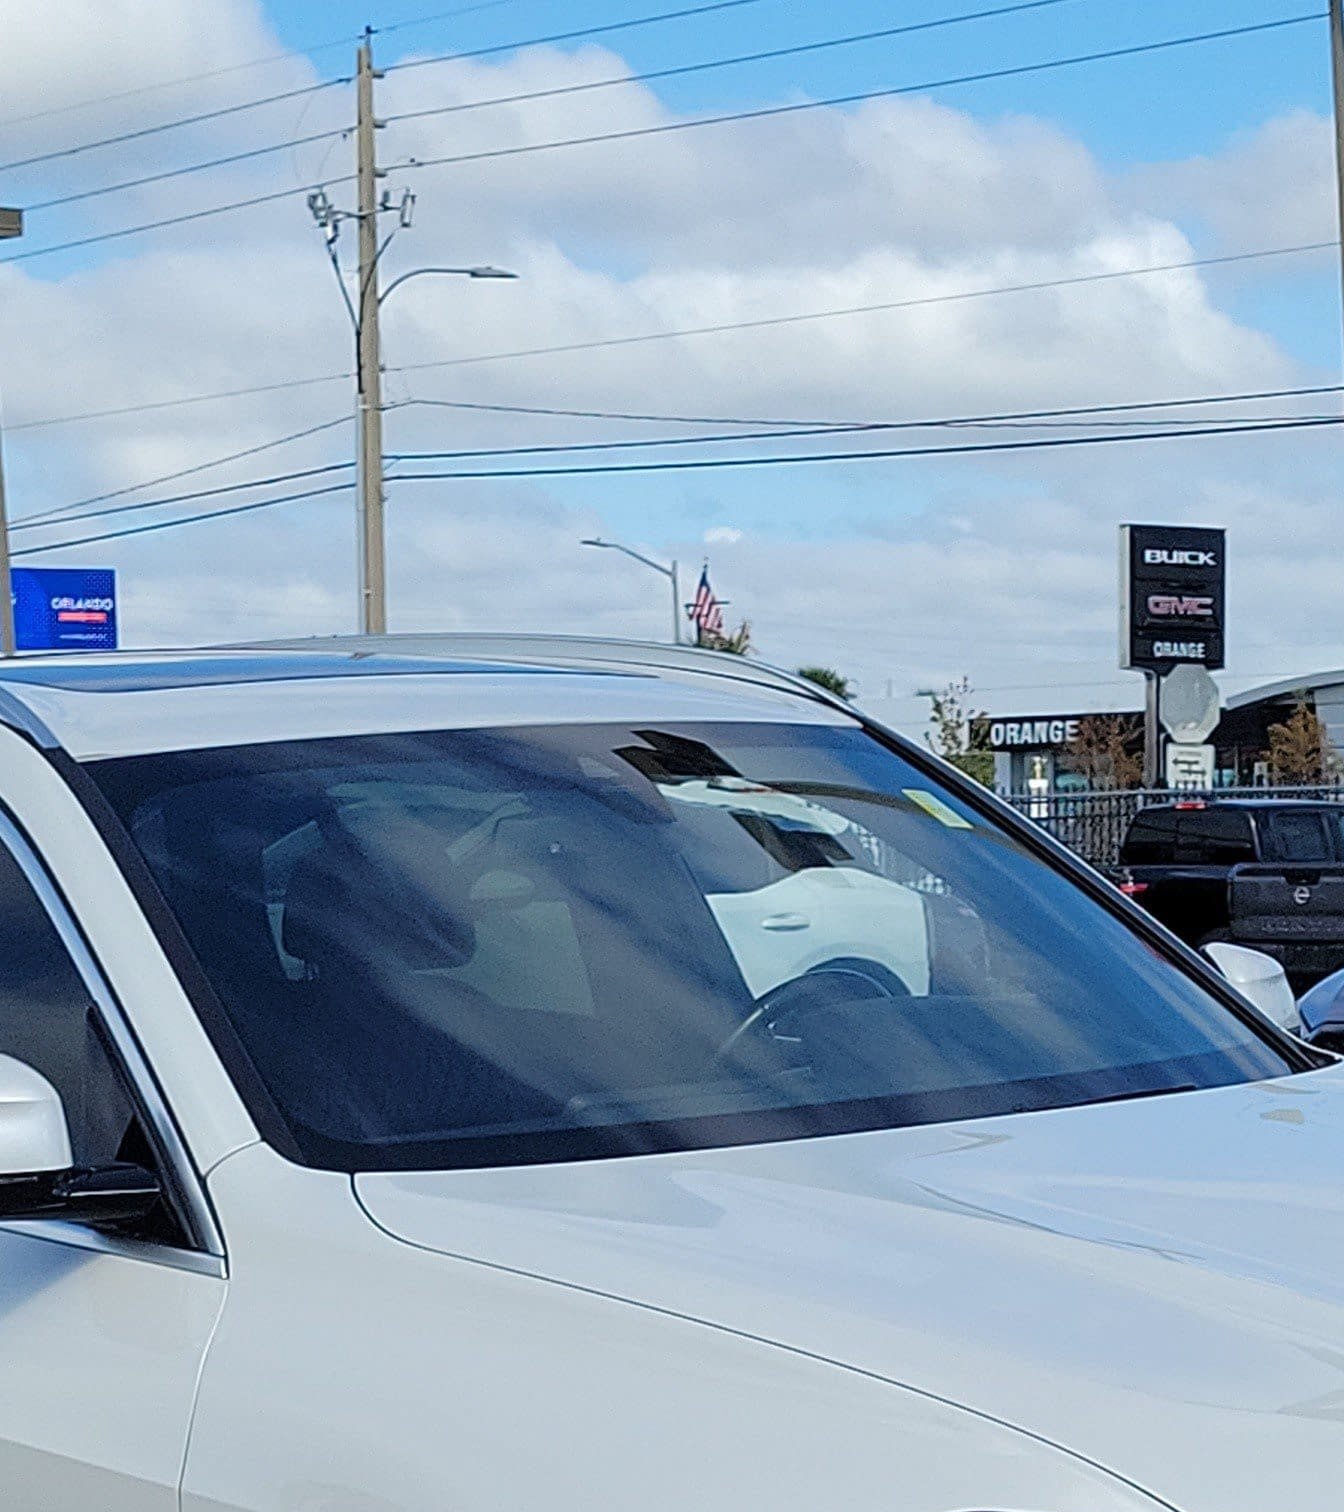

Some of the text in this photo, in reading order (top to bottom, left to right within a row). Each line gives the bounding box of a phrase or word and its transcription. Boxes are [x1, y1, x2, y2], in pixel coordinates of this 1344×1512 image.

[1144, 549, 1217, 566] BUICK
[1147, 595, 1214, 615] GMC
[1153, 640, 1206, 658] ORANGE
[990, 719, 1080, 746] ORANGE
